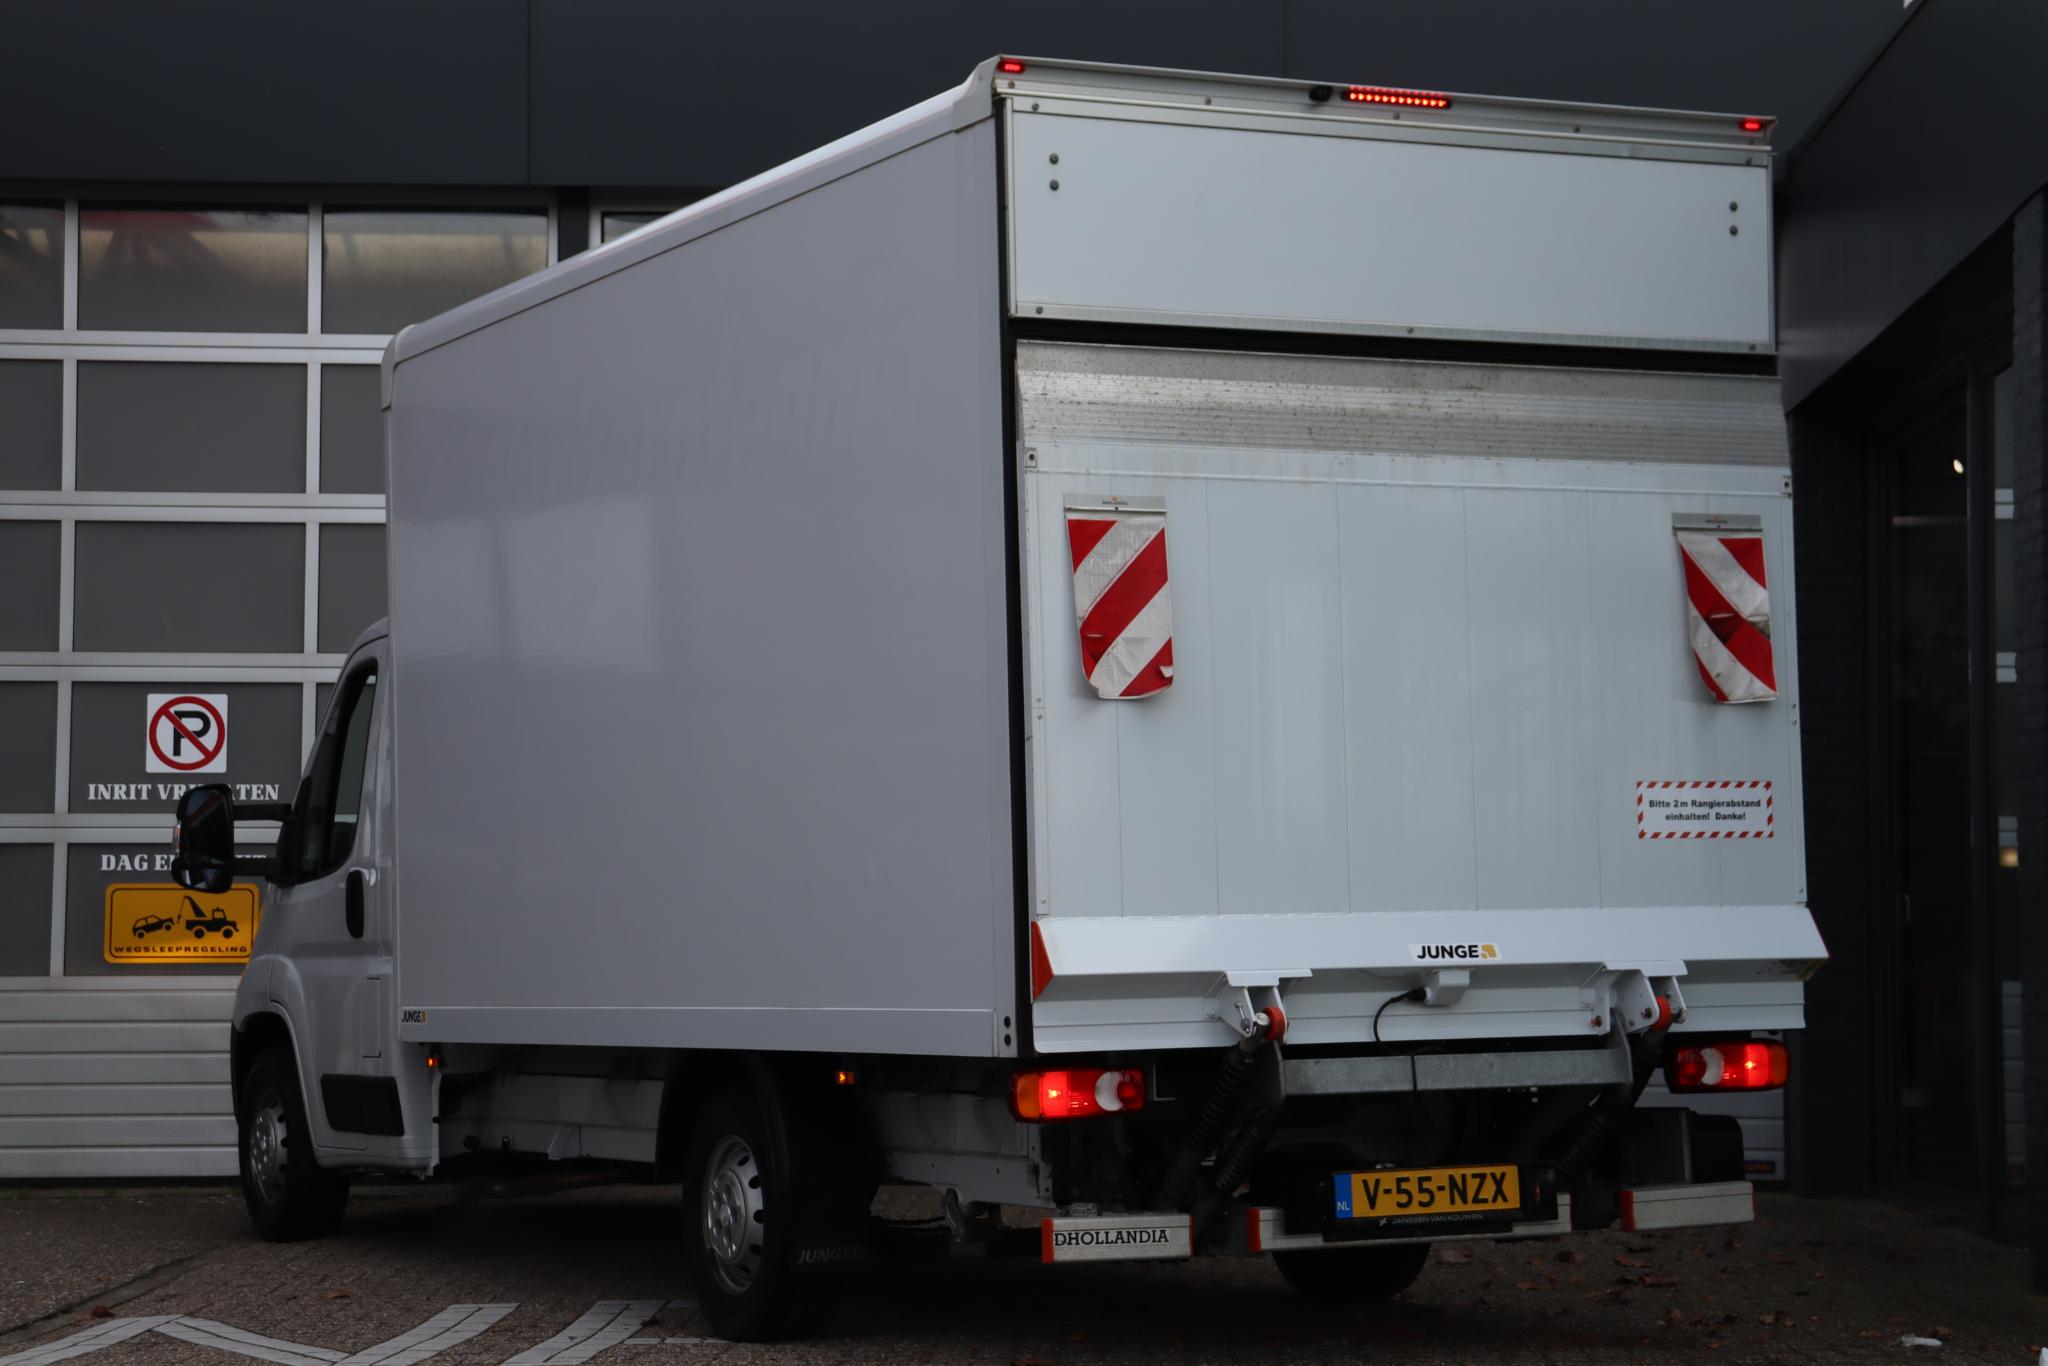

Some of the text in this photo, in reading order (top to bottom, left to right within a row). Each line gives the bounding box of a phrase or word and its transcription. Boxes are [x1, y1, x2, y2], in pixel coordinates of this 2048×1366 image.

[88, 784, 151, 800] INRIT
[1649, 799, 1671, 808] Bitte
[1691, 799, 1761, 809] Rangierabstand
[1665, 812, 1746, 821] einhalten! Danke!
[101, 854, 148, 871] DAG
[1417, 944, 1480, 959] JUNGE
[1362, 1172, 1509, 1210] V-55-NZX
[1337, 1201, 1350, 1211] NL
[1054, 1229, 1169, 1246] DHOLLANDIA
